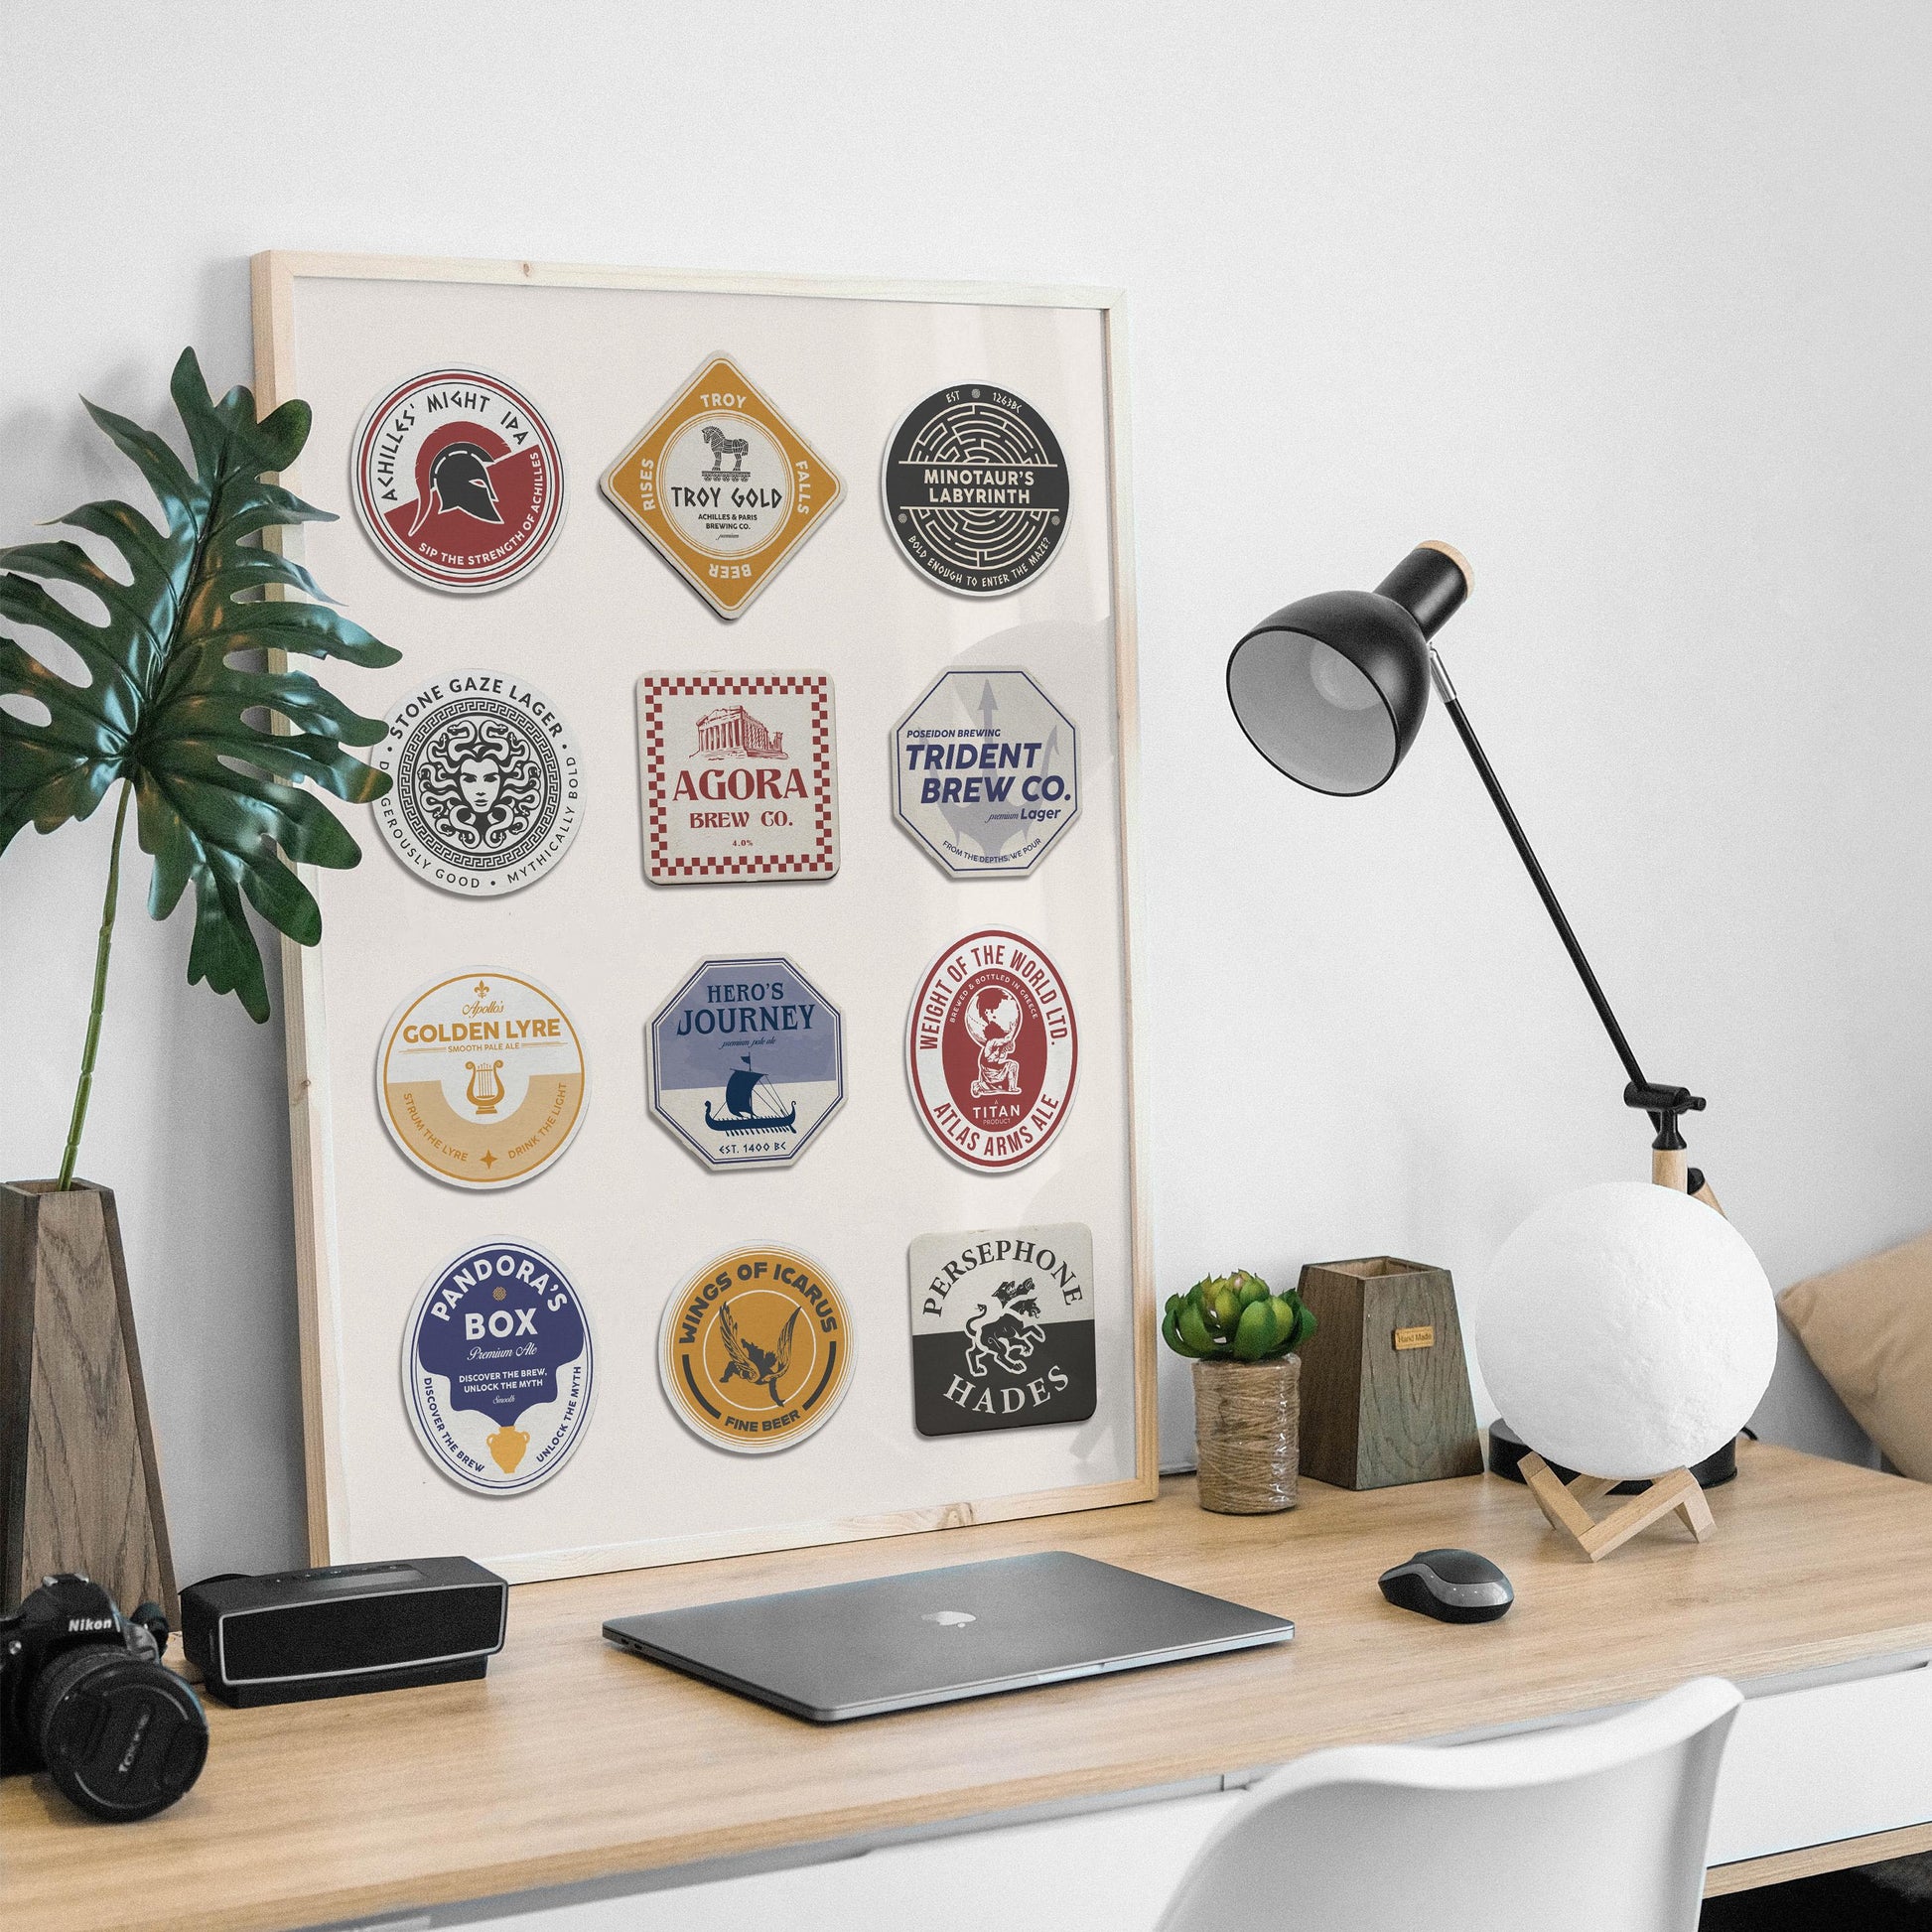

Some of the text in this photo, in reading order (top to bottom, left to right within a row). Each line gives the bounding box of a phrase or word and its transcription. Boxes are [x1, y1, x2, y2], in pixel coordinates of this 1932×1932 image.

[700, 393, 747, 409] TROY
[945, 391, 1023, 414] EST 1263BC
[377, 390, 529, 500] ACHILLES' MIGHT IPA
[639, 459, 656, 511] RISES
[671, 486, 783, 508] TROY GOLD
[795, 460, 811, 515] FALLS
[929, 488, 1031, 504] LABYRINTH
[418, 452, 543, 565] SIP THE STRENGTH OF ACHILLES
[709, 563, 753, 580] BEER
[907, 535, 1050, 587] BOLD ENOUGH TO ENTER THE MAZE?
[390, 676, 563, 740] STONE GAZE LAGER
[957, 729, 1001, 738] BREWING
[905, 743, 1042, 770] TRIDENT
[672, 768, 808, 801] AGORA
[921, 775, 1071, 803] BREW CO.
[379, 760, 480, 888] DGEROUSLY GOOD
[507, 757, 579, 884] MYTHICALLY BOLD
[690, 811, 793, 828] BREW CO.
[1021, 808, 1061, 821] Lager
[943, 840, 963, 857] FROM
[964, 853, 978, 862] THE
[1011, 851, 1023, 860] WE
[1024, 838, 1042, 854] POUR
[919, 945, 1068, 1050] WEIGHT OF THE WORLD LTD.
[950, 989, 969, 1024] BREWED
[975, 974, 1011, 986] BOTTLED
[1011, 980, 1020, 990] IN
[1020, 989, 1038, 1020] GREECE
[403, 1018, 561, 1043] GOLDEN LYRE
[676, 1004, 816, 1036] JOURNEY
[507, 1082, 567, 1160] DRINK THE LIGHT
[933, 1094, 1059, 1157] ATLAS ARMS ALE
[972, 1104, 1021, 1119] TITAN
[403, 1093, 468, 1162] STRUM THE LYRE
[719, 1142, 786, 1155] EST. 1400 BC
[922, 1240, 1083, 1317] PERSEPHONE
[679, 1262, 838, 1344] WINGS OF ICARUS
[465, 1309, 538, 1340] BOX
[467, 1342, 538, 1361] Premium Ale
[459, 1368, 547, 1383] DISCOVER THE BREW,
[464, 1379, 543, 1393] UNLOCK THE MYTH
[943, 1365, 1068, 1414] HADES
[424, 1377, 484, 1472] DISCOVER THE BREW
[536, 1366, 582, 1463] UNLOCK THE MYTH
[725, 1410, 800, 1432] FINE BEER
[69, 1618, 112, 1632] Nikon
